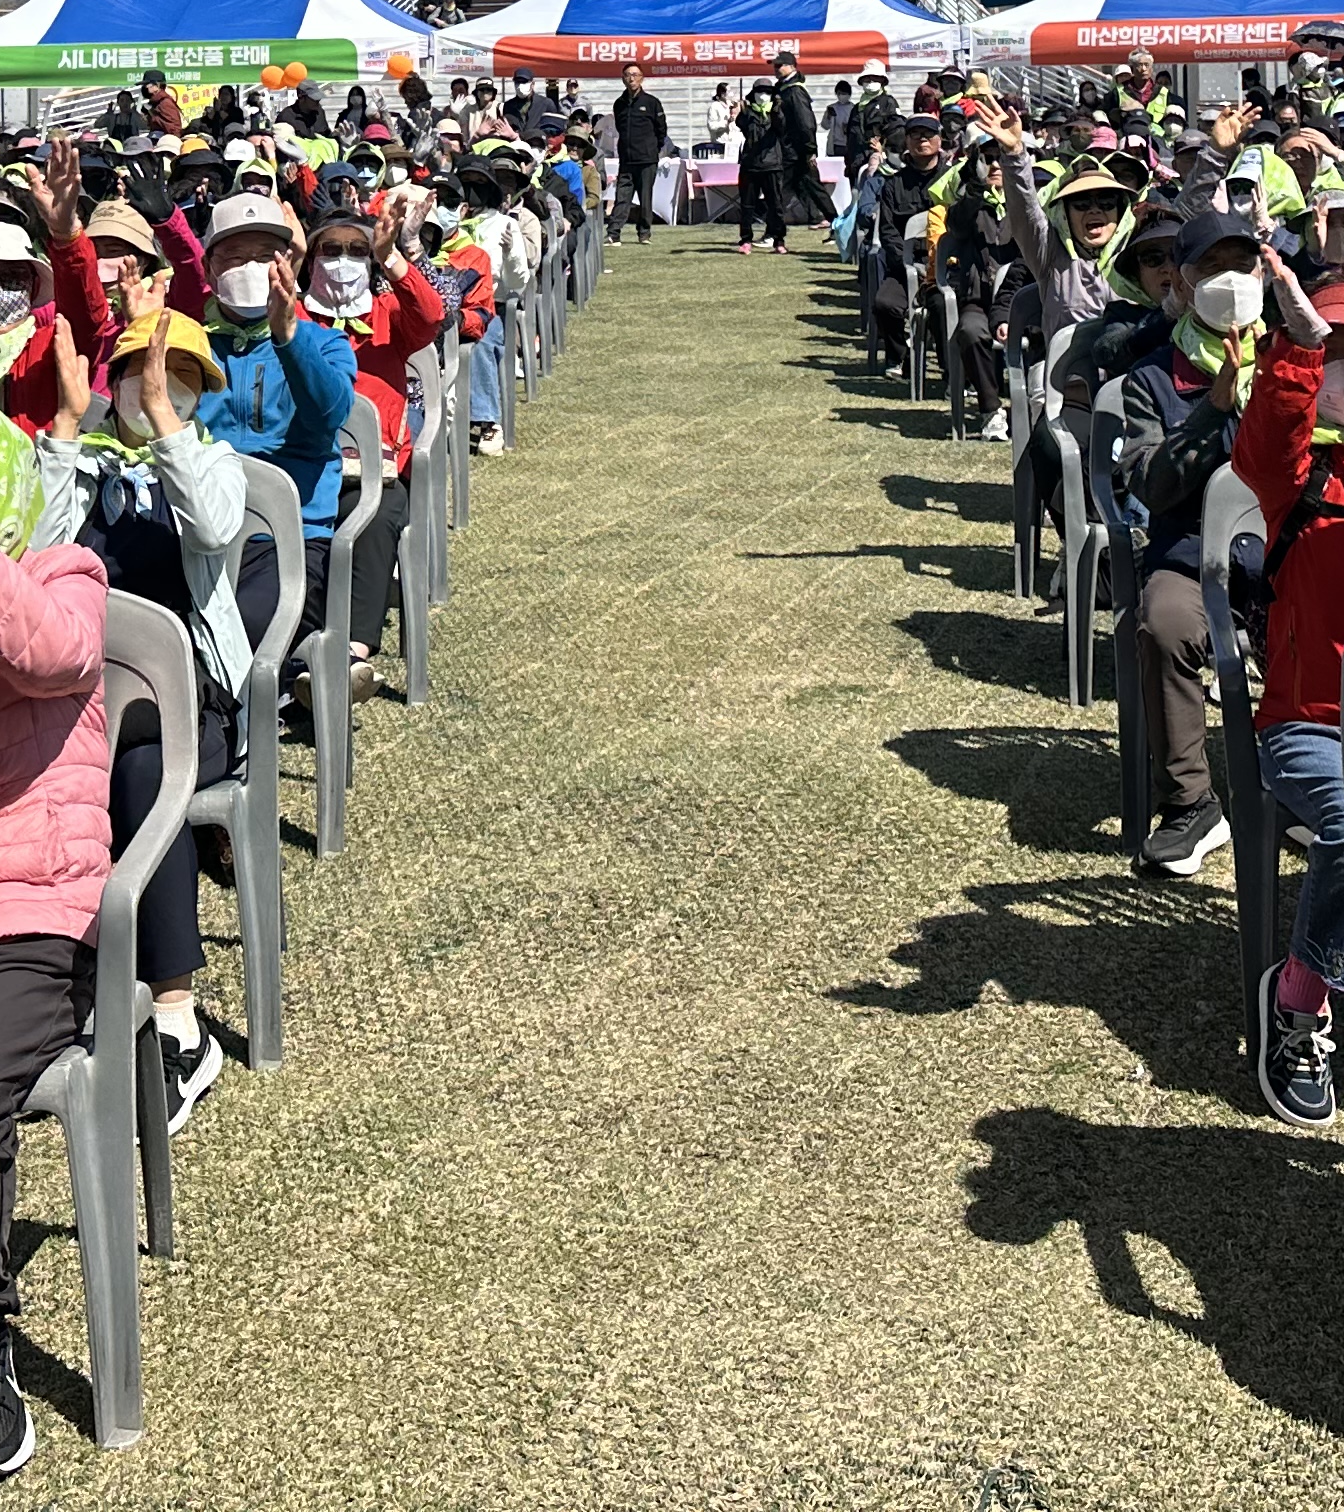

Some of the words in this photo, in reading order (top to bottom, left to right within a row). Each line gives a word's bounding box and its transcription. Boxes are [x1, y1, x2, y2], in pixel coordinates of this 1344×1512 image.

[1077, 22, 1287, 47] 마산희망지역자활센터
[57, 48, 158, 69] 시니어클럽
[164, 46, 224, 68] 생산품
[229, 45, 271, 66] 판매
[578, 41, 637, 62] 다양한
[642, 41, 688, 63] 가족,
[693, 39, 754, 61] 행복한
